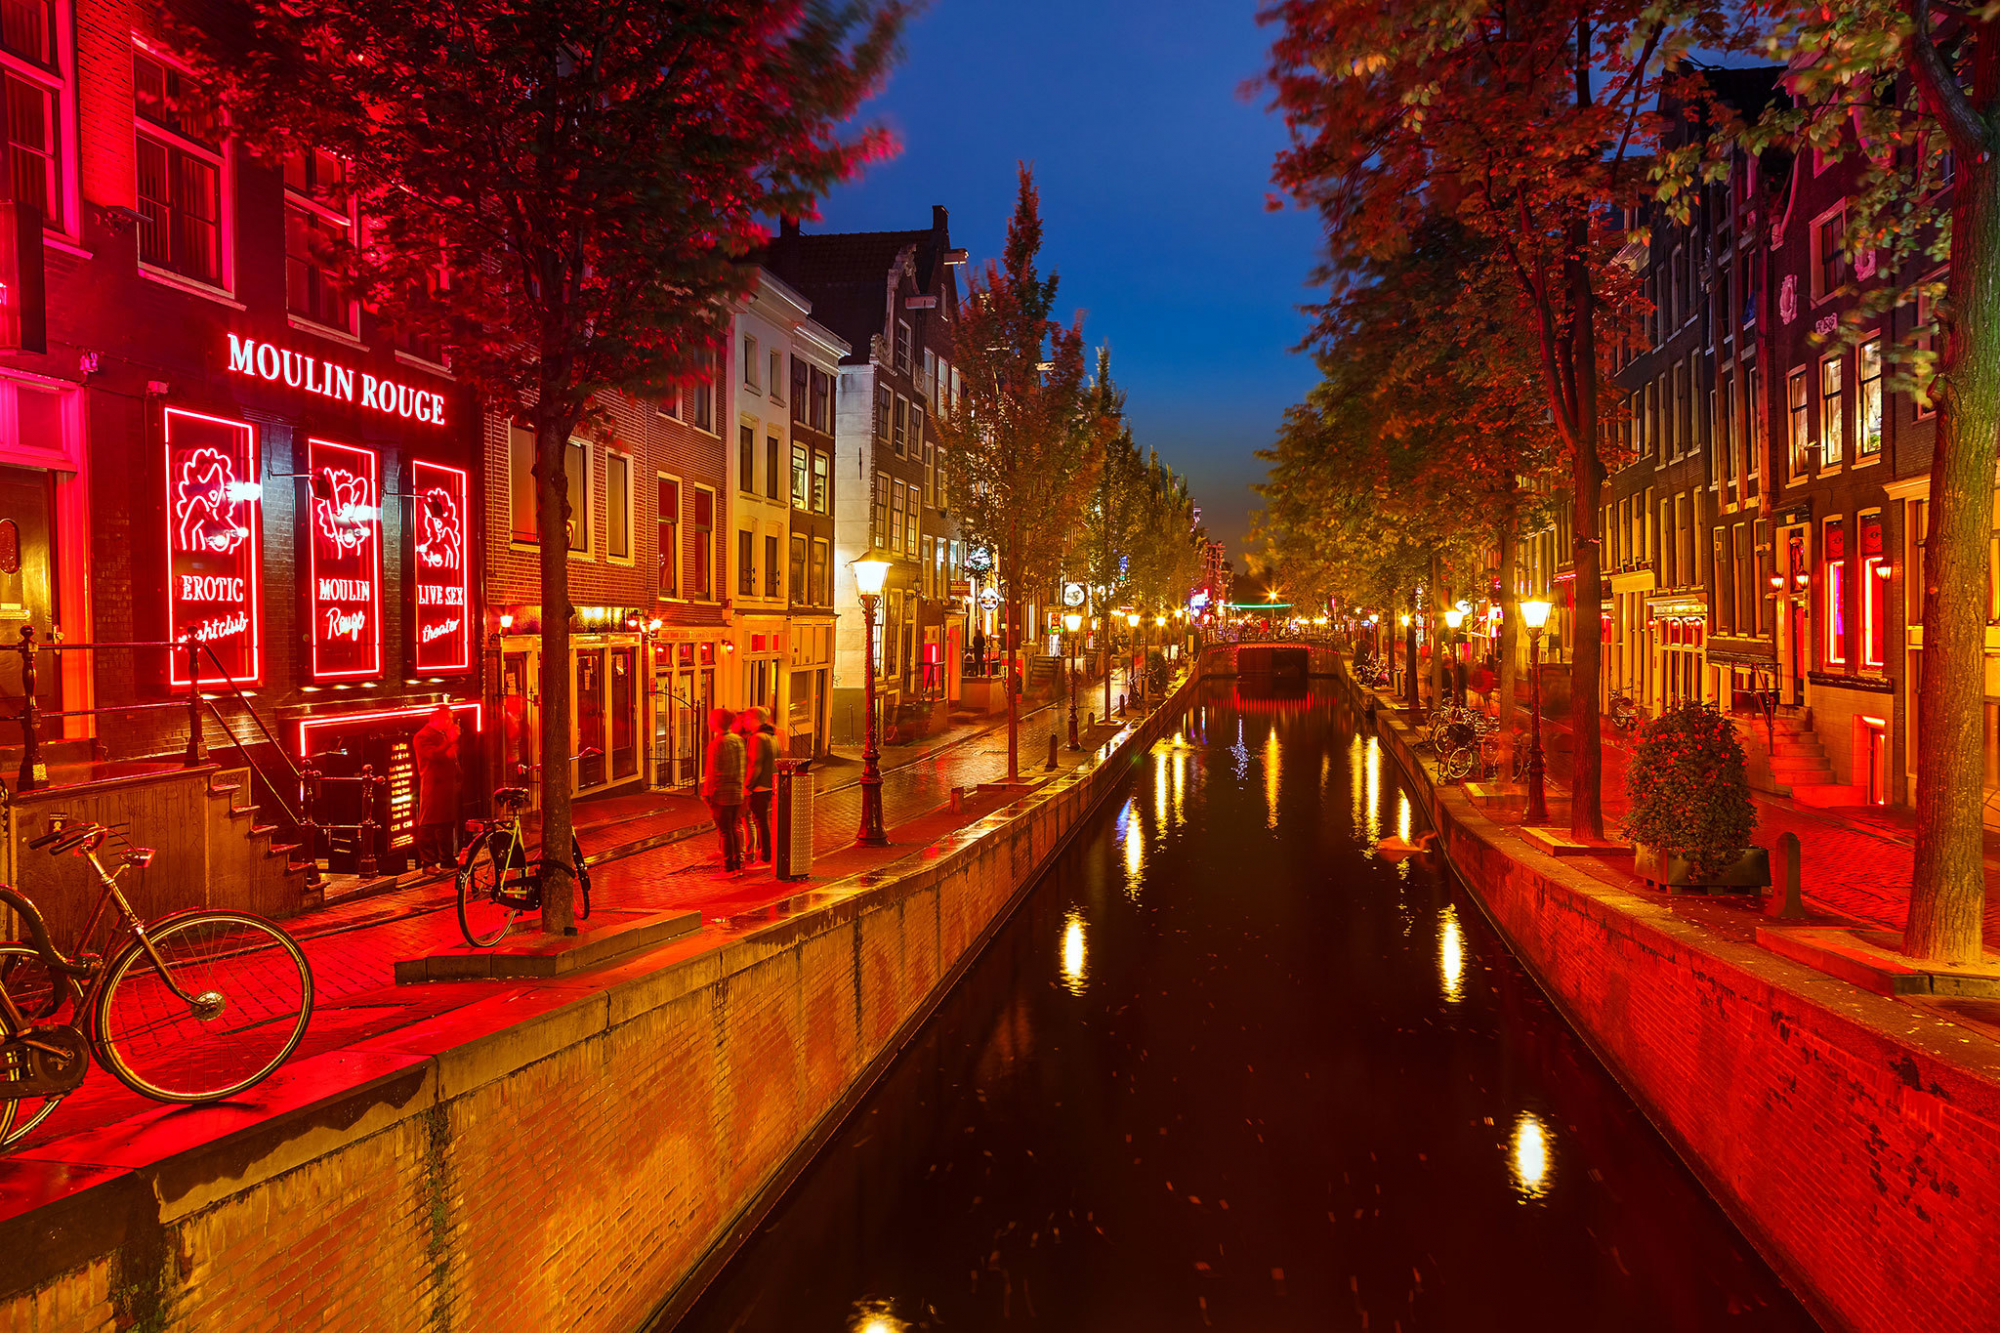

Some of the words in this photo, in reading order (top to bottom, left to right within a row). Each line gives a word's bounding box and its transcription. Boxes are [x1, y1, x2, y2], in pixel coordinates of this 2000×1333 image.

[227, 333, 354, 402] MOULIN
[361, 373, 445, 425] ROUGE
[181, 575, 243, 602] EROTIC
[318, 578, 370, 602] MOULIN
[417, 584, 443, 605] LIVE
[445, 586, 463, 605] SEX
[325, 607, 365, 642] Rouge
[422, 618, 460, 642] theater
